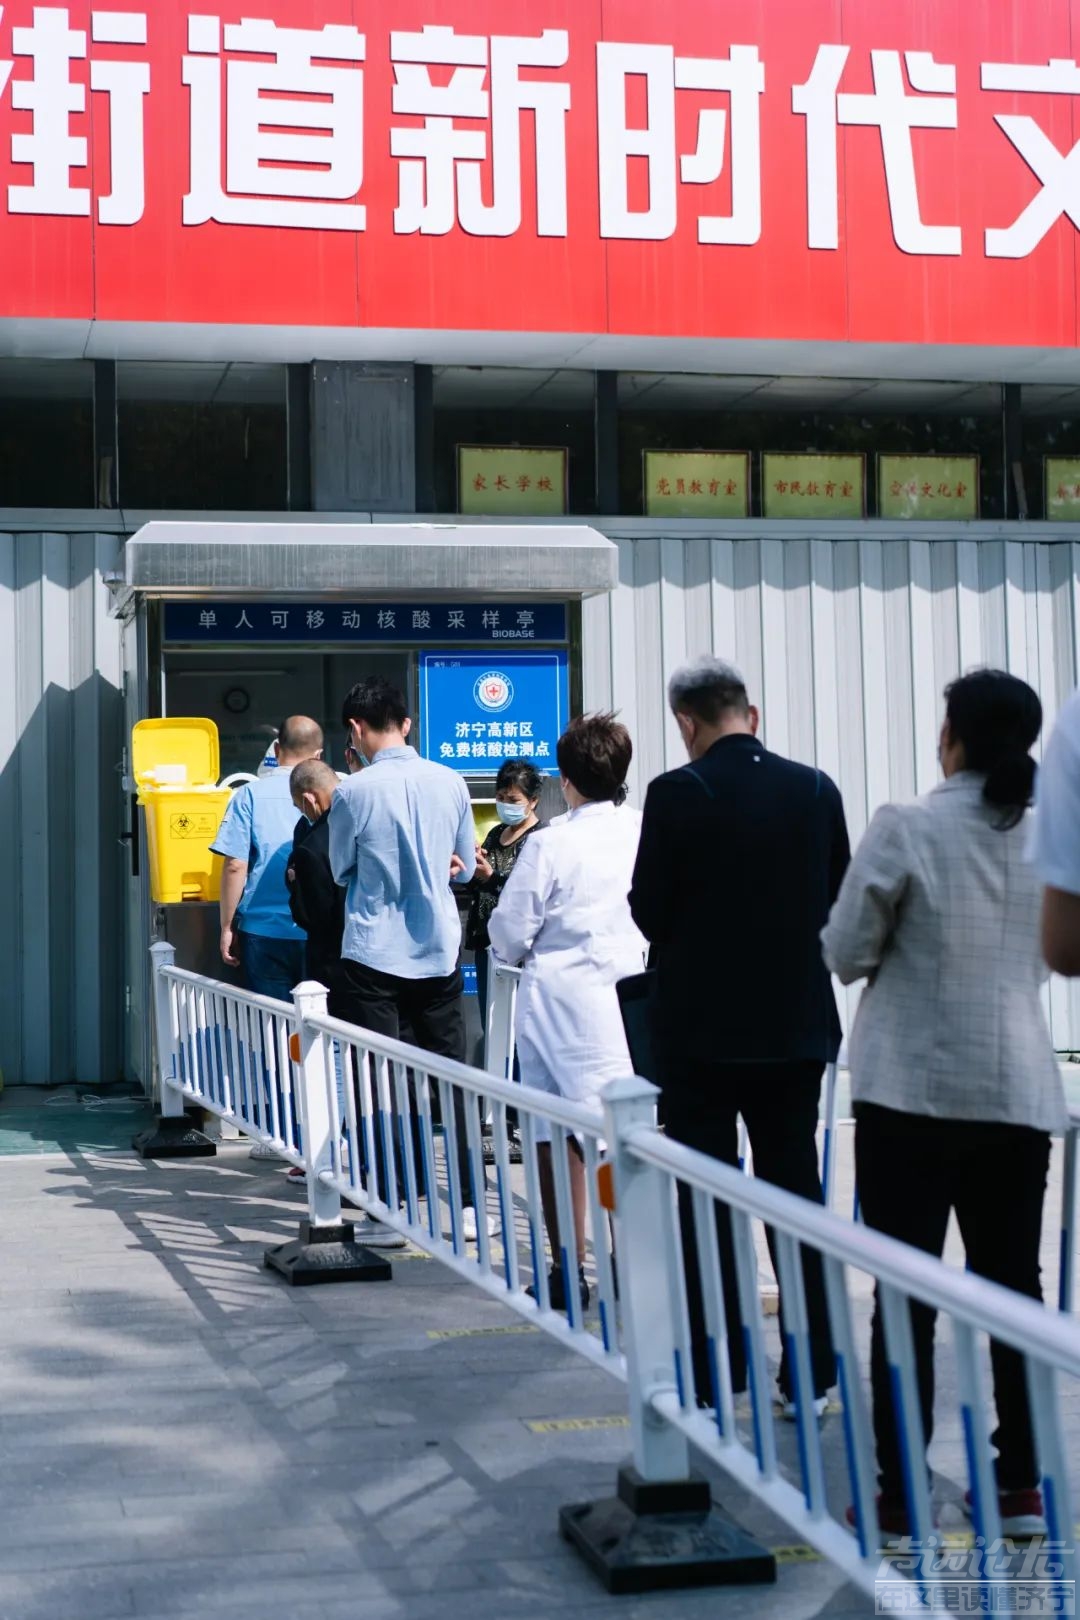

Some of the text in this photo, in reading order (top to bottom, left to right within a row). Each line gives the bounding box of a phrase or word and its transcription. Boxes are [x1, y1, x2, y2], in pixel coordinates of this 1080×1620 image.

[0, 5, 1080, 259] 街道新时代文
[472, 472, 554, 492] 家长学校
[656, 477, 738, 497] 党员教育室
[198, 609, 535, 630] 单人可移动核酸采样亭
[492, 629, 535, 638] BIOBASE
[455, 721, 534, 738] 济宁高新区
[439, 740, 550, 758] 免费核酸检测点
